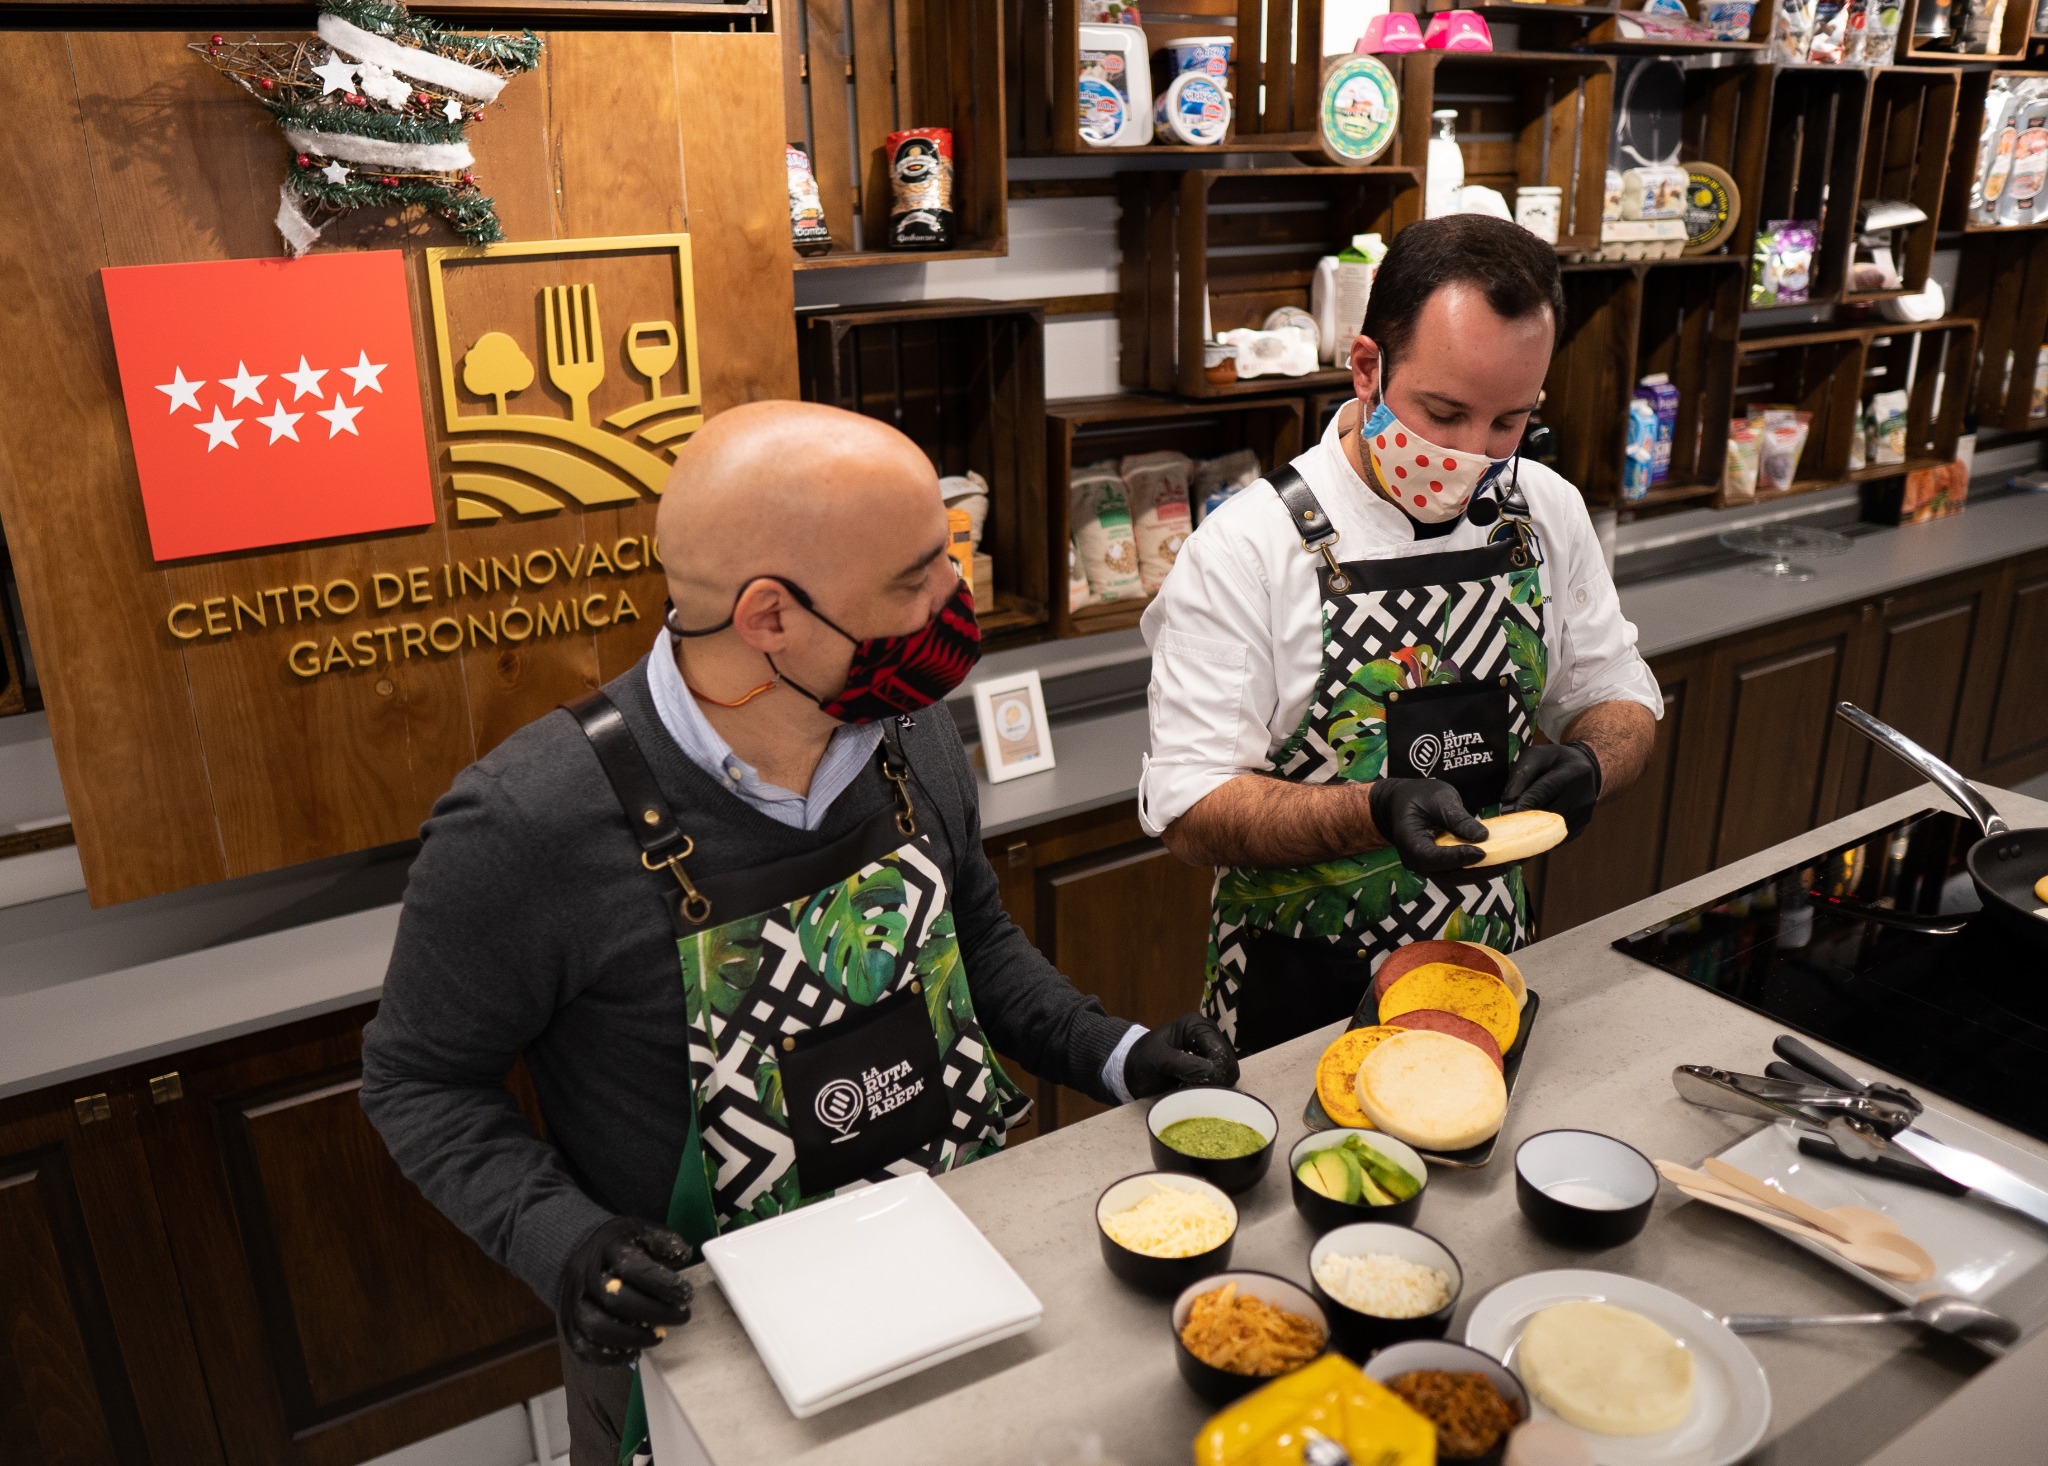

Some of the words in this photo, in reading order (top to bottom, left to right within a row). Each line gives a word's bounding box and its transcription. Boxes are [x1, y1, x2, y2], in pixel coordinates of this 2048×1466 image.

[167, 579, 360, 640] CENTRO
[373, 567, 433, 609] DE
[288, 588, 641, 677] GASTRONÓMICA
[1442, 729, 1456, 740] LA
[1443, 732, 1485, 750] RUTA
[1442, 751, 1494, 771] AREPA
[1443, 749, 1456, 759] DE
[1457, 746, 1470, 756] LA
[862, 1067, 879, 1081] LA
[864, 1060, 912, 1095] RUTA
[867, 1091, 882, 1106] DE
[884, 1083, 902, 1097] LA
[869, 1079, 924, 1120] AREPA
